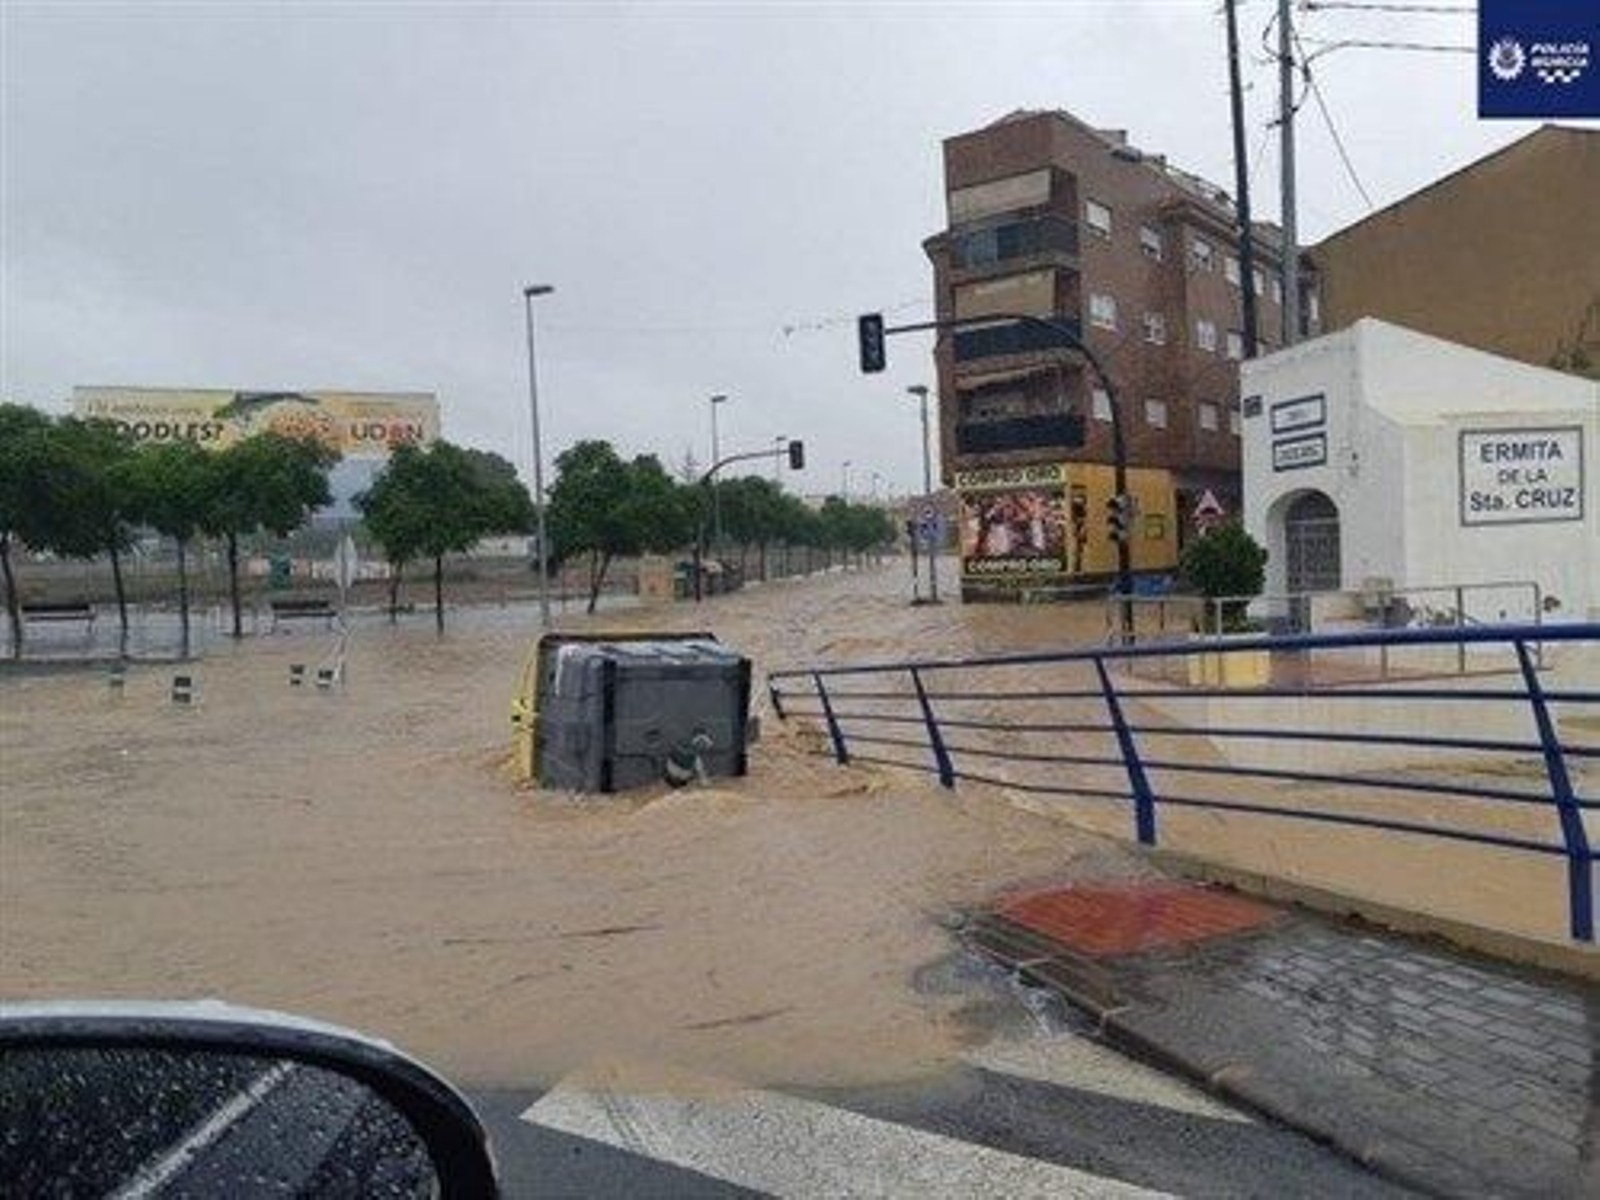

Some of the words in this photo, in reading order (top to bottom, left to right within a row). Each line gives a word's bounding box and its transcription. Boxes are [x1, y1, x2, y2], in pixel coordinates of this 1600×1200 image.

[1480, 441, 1564, 463] ERMITA
[1026, 463, 1061, 483] ORO
[1497, 468, 1520, 484] DE
[1524, 467, 1549, 483] LA
[1470, 491, 1512, 512] Sta.
[1515, 487, 1576, 509] CRUZ
[967, 558, 1027, 574] COMPRO
[1028, 557, 1062, 573] ORO
